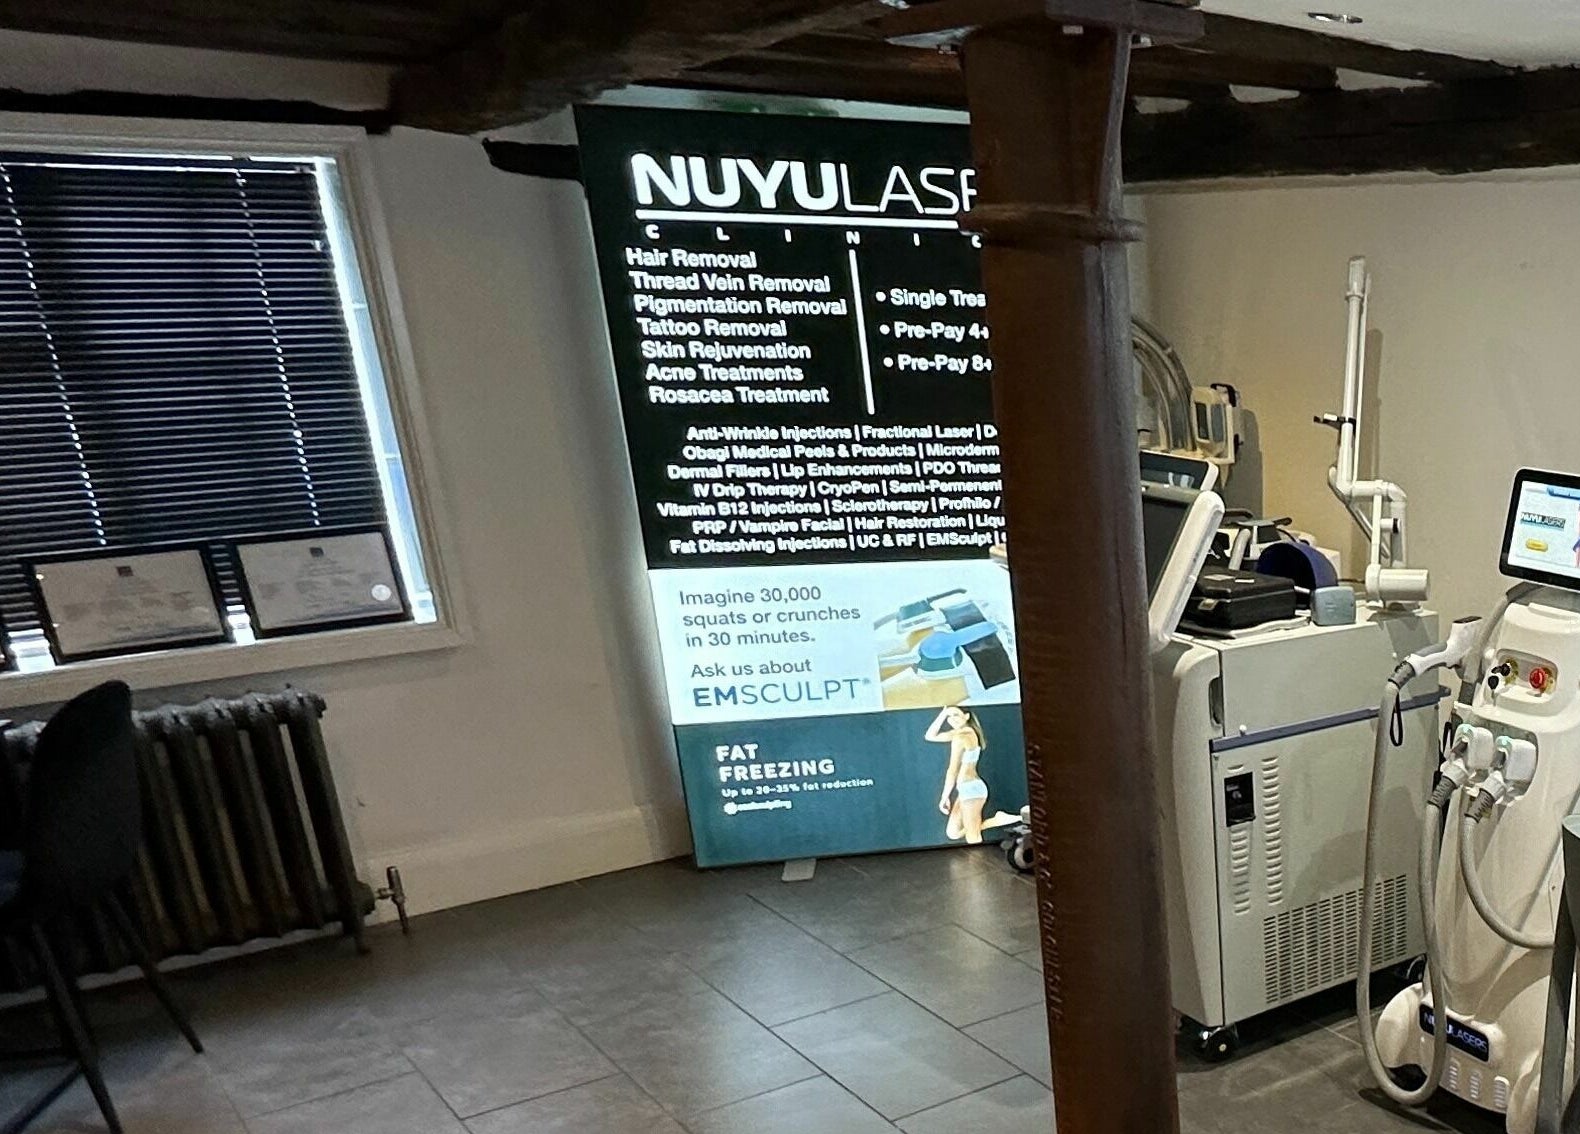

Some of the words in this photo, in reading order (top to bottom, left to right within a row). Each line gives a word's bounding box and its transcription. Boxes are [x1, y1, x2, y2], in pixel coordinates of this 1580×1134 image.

[626, 248, 668, 266] Hair
[671, 249, 757, 268] Removal
[629, 271, 699, 290] Thread
[702, 273, 745, 290] Vein
[749, 274, 830, 292] Removal
[634, 294, 762, 316] Pigmentation
[766, 297, 847, 314] Removal
[890, 288, 946, 309] Single
[636, 317, 700, 335] Tattoo
[704, 319, 787, 336] Removal
[894, 322, 965, 342] Pre-Pay
[641, 340, 685, 358] Skin
[689, 341, 811, 362] Rejuvenation
[646, 363, 696, 381] Acne
[698, 364, 804, 381] Treatments
[898, 354, 968, 374] Pre-Pay
[649, 386, 734, 403] Rosacea
[735, 387, 829, 403] Treatment
[687, 426, 779, 440] Anti-Wrinkle
[781, 426, 852, 442] Injections
[862, 425, 932, 438] Fractional
[935, 425, 974, 438] Laser
[683, 446, 730, 462] Obagi
[732, 445, 791, 459] Medical
[794, 445, 835, 458] Peels
[852, 444, 916, 457] Products
[667, 464, 723, 479] Dermal
[725, 464, 771, 477] Fillers
[781, 464, 804, 479] Lip
[807, 463, 913, 476] Enhancements
[923, 461, 955, 474] PDO
[693, 484, 709, 497] IV
[712, 483, 745, 499] Drip
[746, 483, 807, 498] Therapy
[657, 503, 715, 516] Vitamin
[718, 502, 749, 515] B12
[751, 501, 821, 517] Injections
[832, 499, 929, 513] Sclerotherapy
[692, 520, 727, 534] PRP
[738, 520, 798, 535] Vampire
[801, 518, 845, 531] Facial
[855, 517, 884, 529] Hair
[887, 515, 966, 529] Restoration
[670, 540, 697, 553] Fat
[698, 538, 775, 553] Dissolving
[777, 537, 847, 552] Injections
[896, 533, 916, 546] RF
[926, 532, 992, 546] EMSculpt
[680, 589, 755, 607] Imagine
[761, 586, 821, 603] 30,000
[683, 611, 747, 629] squats
[753, 612, 771, 623] or
[777, 606, 860, 623] crunches
[686, 634, 702, 647] in
[708, 632, 731, 646] 30
[737, 630, 815, 645] minutes.
[691, 663, 726, 678] Ask
[732, 665, 753, 676] us
[759, 659, 812, 674] about
[716, 744, 758, 761] FAT
[719, 759, 834, 782] FREEZING
[722, 789, 738, 798] Up
[822, 779, 873, 789] reduction
